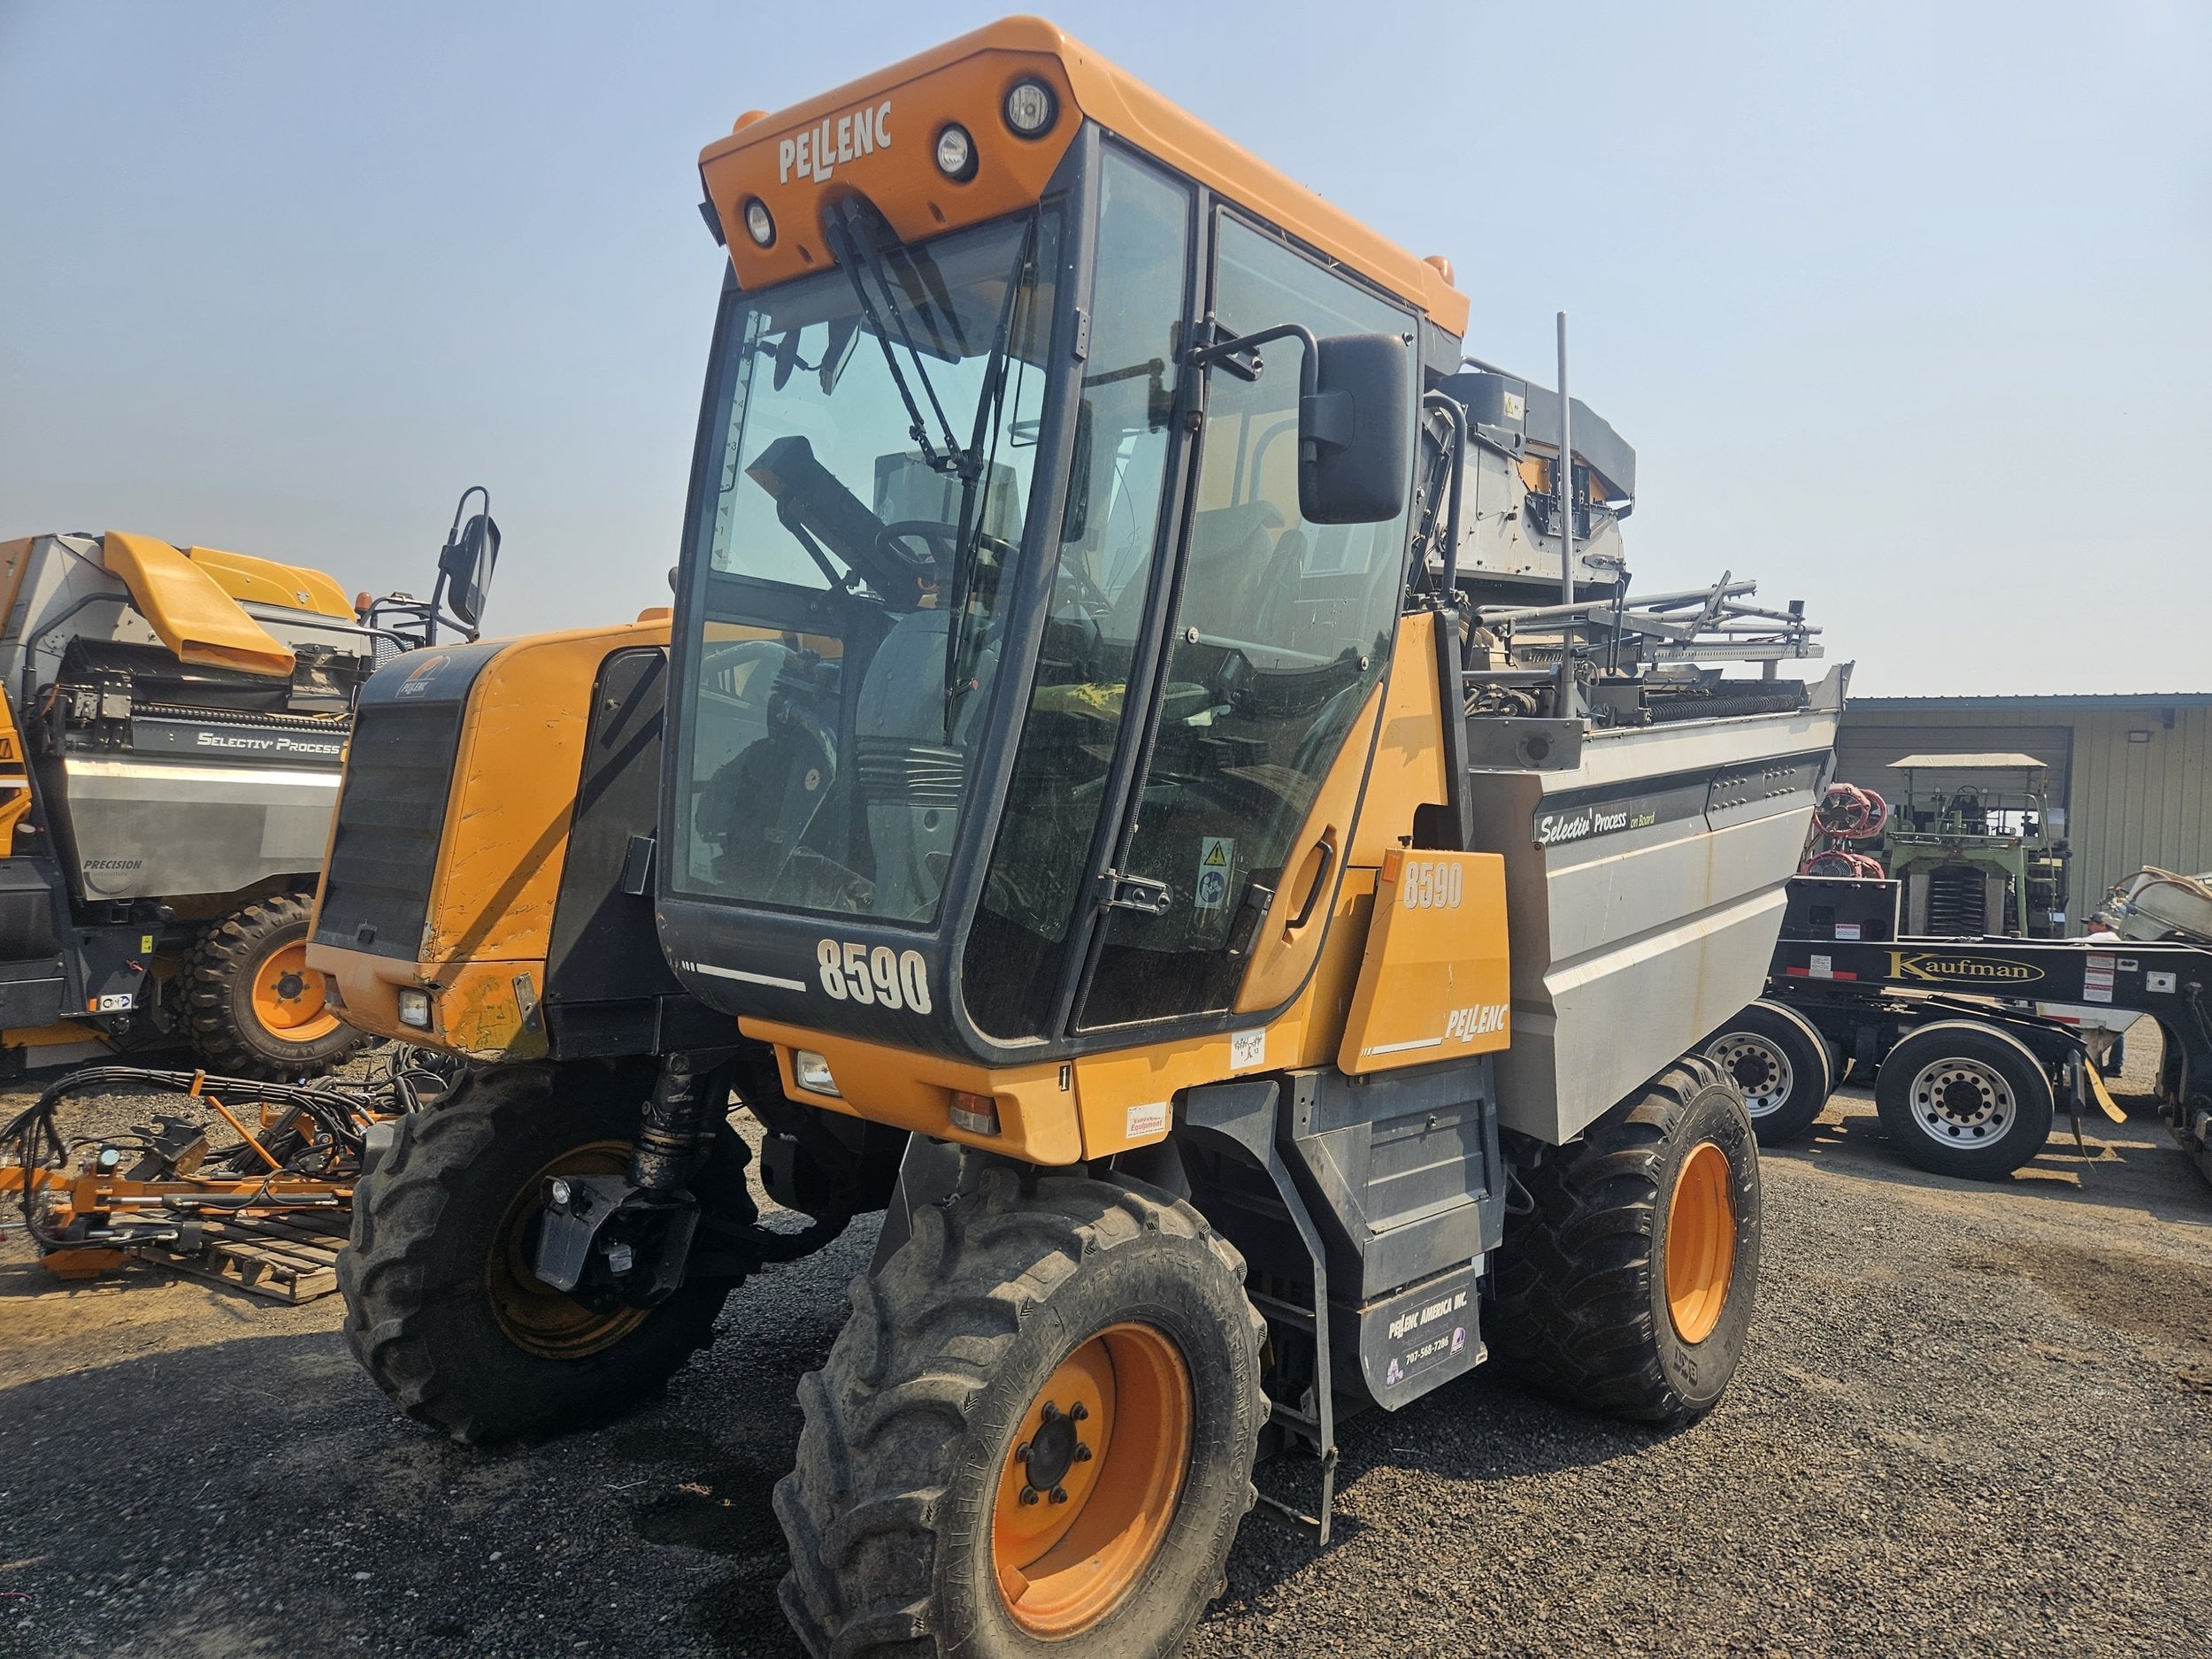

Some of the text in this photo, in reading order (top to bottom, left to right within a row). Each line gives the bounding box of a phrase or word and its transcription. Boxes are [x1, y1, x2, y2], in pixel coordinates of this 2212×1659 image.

[780, 101, 892, 184] PELLENC
[276, 738, 341, 755] PROCESS
[1594, 812, 1627, 833] Process
[1631, 817, 1639, 829] on
[1639, 810, 1655, 827] Board
[83, 860, 142, 870] PRECISION
[1403, 861, 1463, 910] 8590
[817, 938, 933, 1015] 8590
[1883, 950, 2030, 982] Kaufman
[1444, 1003, 1509, 1043] PELLENC
[1131, 1119, 1163, 1132] Equipment
[1388, 1311, 1419, 1340] PELLENC
[1420, 1298, 1452, 1325] AMERICA
[1454, 1291, 1467, 1310] INC.
[1406, 1336, 1449, 1365] 707-568-7286
